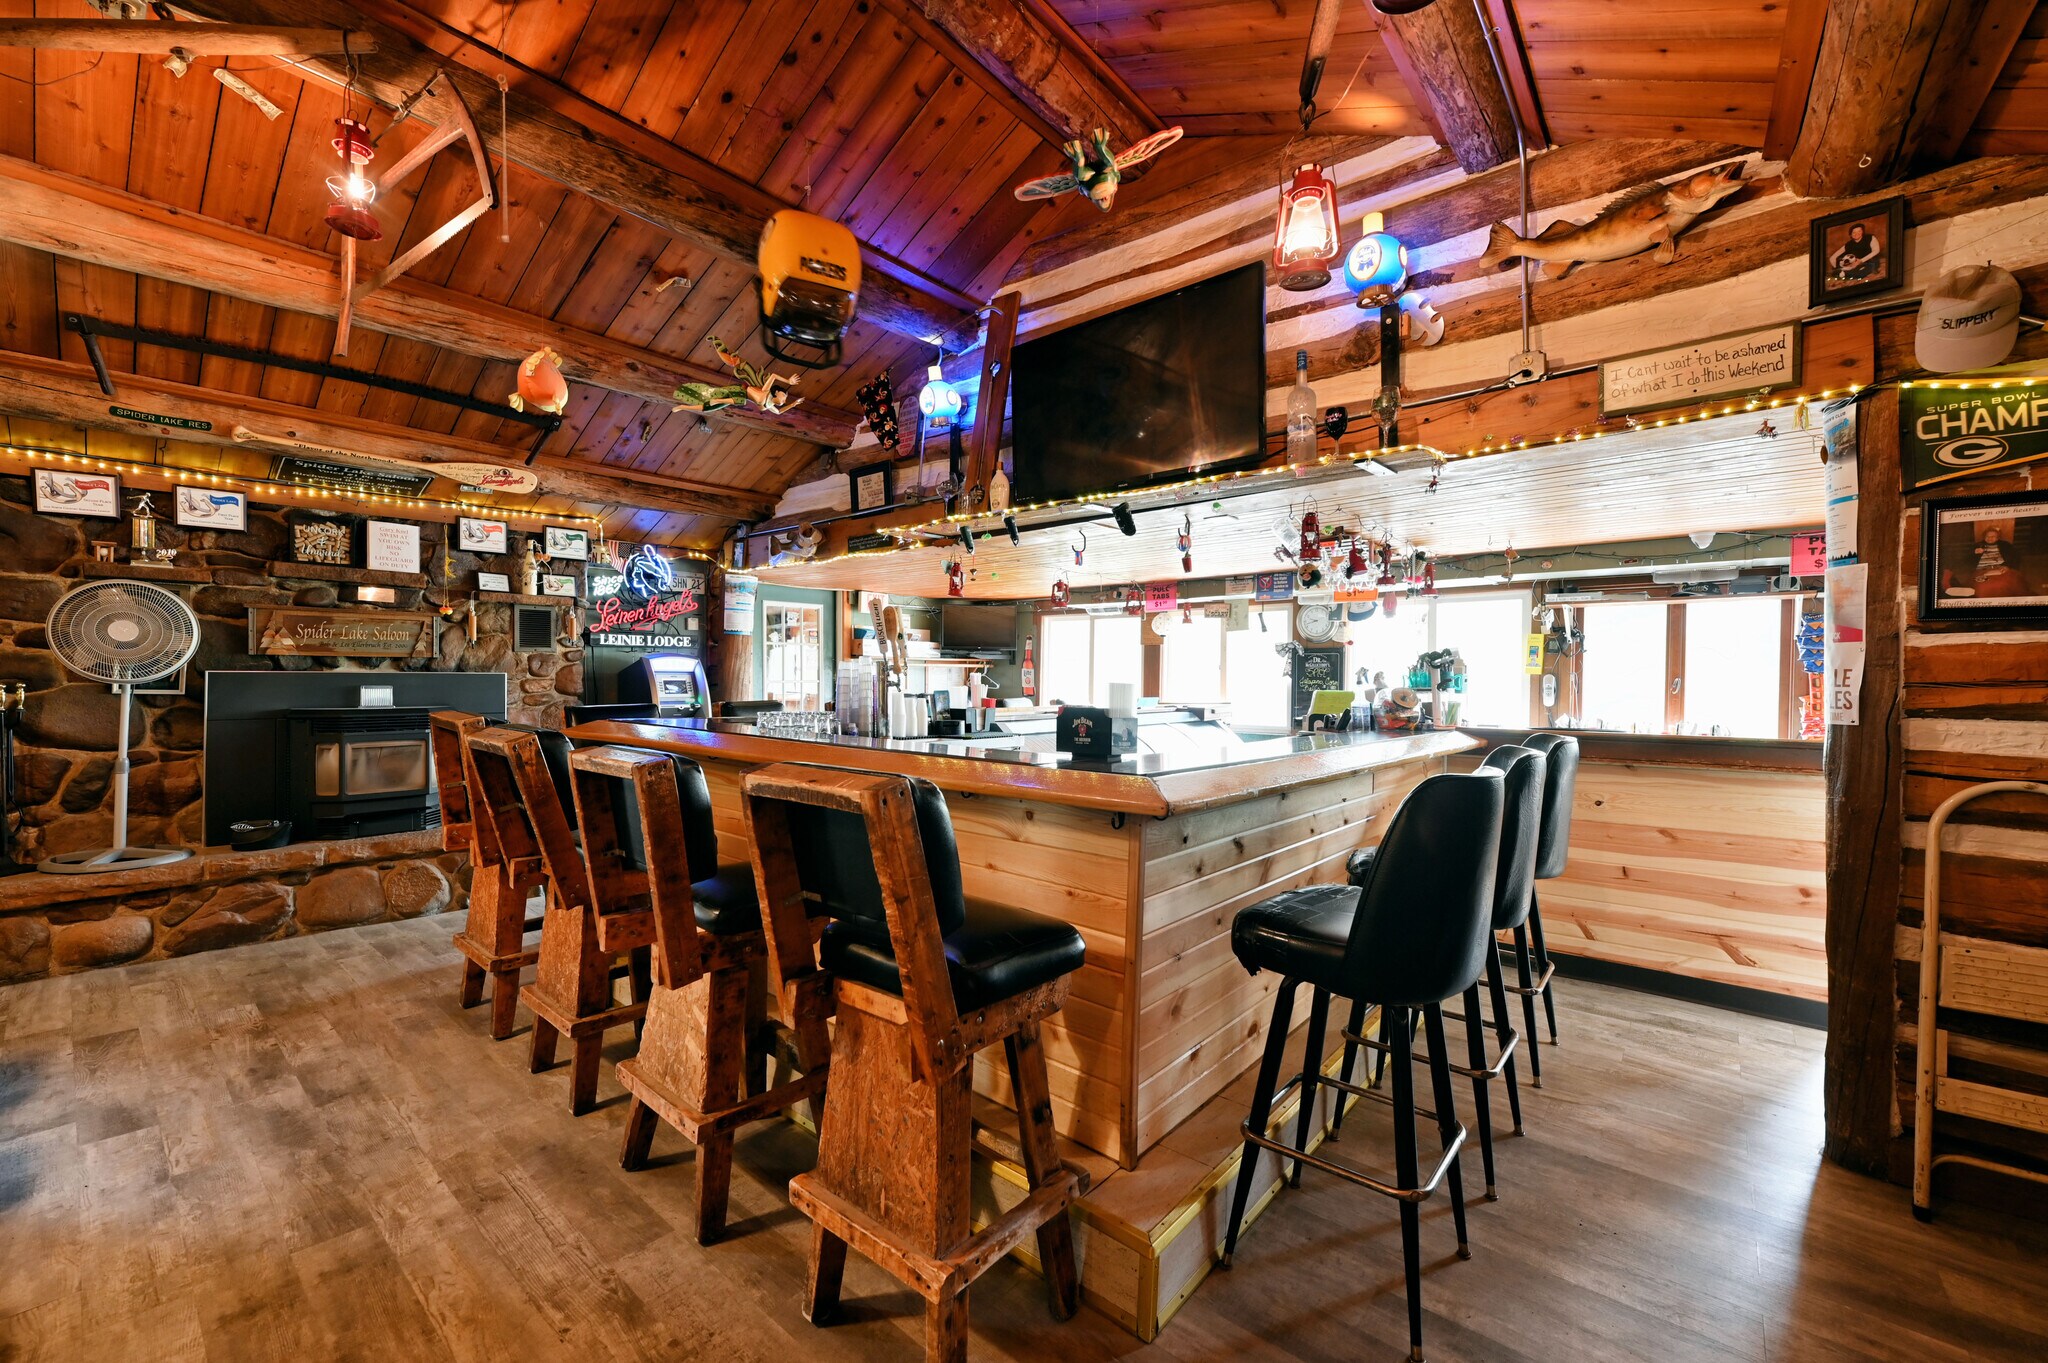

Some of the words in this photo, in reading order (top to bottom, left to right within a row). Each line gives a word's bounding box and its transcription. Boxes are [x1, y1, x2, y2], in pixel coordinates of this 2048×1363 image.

[801, 256, 847, 281] PACKERS
[1942, 309, 1996, 330] SLIPPERY
[1611, 369, 1623, 382] I
[1663, 355, 1693, 371] wait
[1696, 352, 1712, 366] to
[1715, 349, 1729, 363] be
[1732, 334, 1787, 358] ashamed
[1632, 377, 1667, 394] what
[1671, 374, 1684, 388] I
[1687, 371, 1701, 386] do
[1701, 366, 1725, 382] this
[1926, 400, 1982, 414] SUPER
[1991, 392, 2040, 405] BOWL
[117, 408, 155, 422] SPIDER
[160, 416, 184, 426] LAKE
[188, 421, 208, 429] RES
[1938, 438, 2003, 465] G
[295, 460, 340, 471] Spider
[344, 467, 374, 476] Lake
[378, 472, 419, 482] Saloon
[1949, 511, 1981, 519] Forever
[2012, 506, 2041, 514] hearts
[303, 524, 345, 537] UNCORK
[301, 544, 342, 558] Unwind
[375, 556, 414, 564] LIFEGUARD
[873, 604, 881, 621] LIGHT
[295, 621, 336, 646] Spider
[340, 623, 368, 640] Lake
[373, 624, 410, 641] Saloon
[600, 634, 644, 647] LEINIE
[647, 636, 692, 647] LODGE
[876, 621, 887, 645] BUSCH
